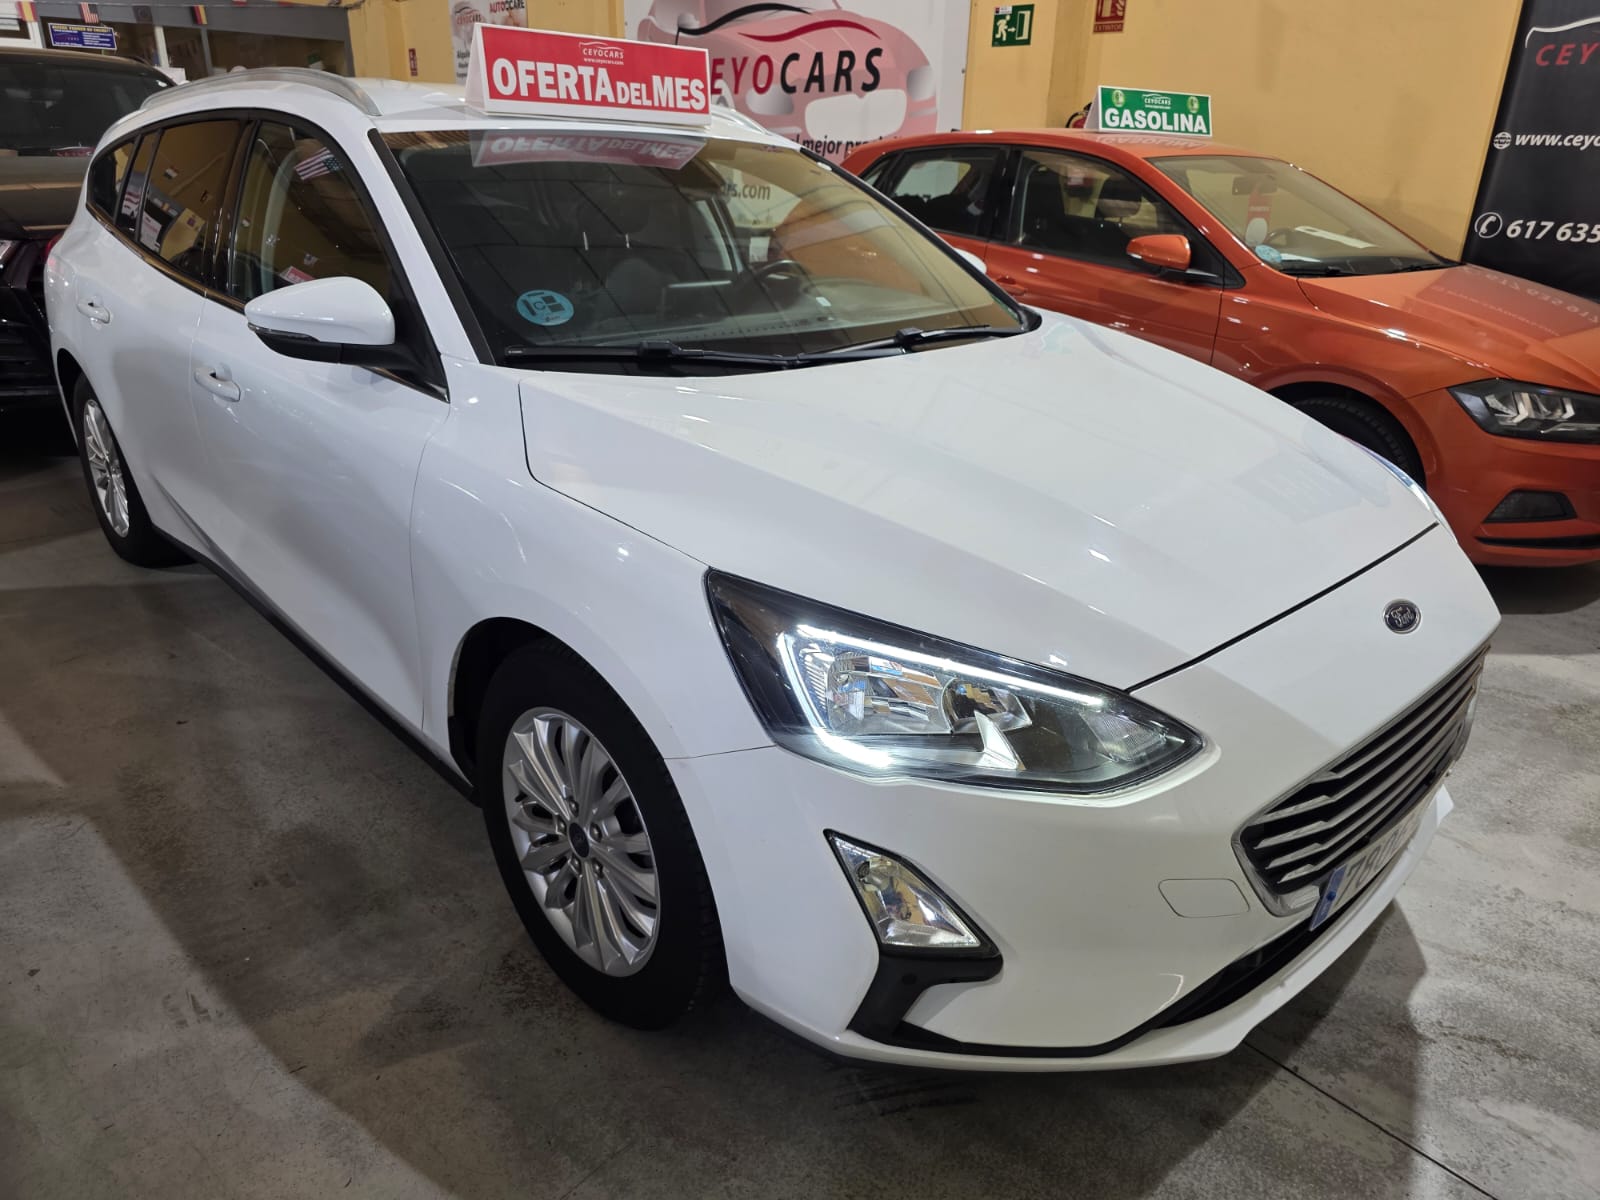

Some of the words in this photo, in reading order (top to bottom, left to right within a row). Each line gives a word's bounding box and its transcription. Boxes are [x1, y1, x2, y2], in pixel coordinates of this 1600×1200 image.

[583, 48, 624, 59] CEYOCARS
[1536, 42, 1600, 66] CEY
[711, 48, 883, 95] EYOCARS
[492, 58, 615, 103] OFERTA
[616, 81, 653, 106] DEL
[652, 75, 706, 110] MES
[1104, 108, 1207, 133] GASOLINA
[802, 135, 843, 157] mejor
[1505, 219, 1555, 239] 617
[1555, 222, 1600, 243] 635
